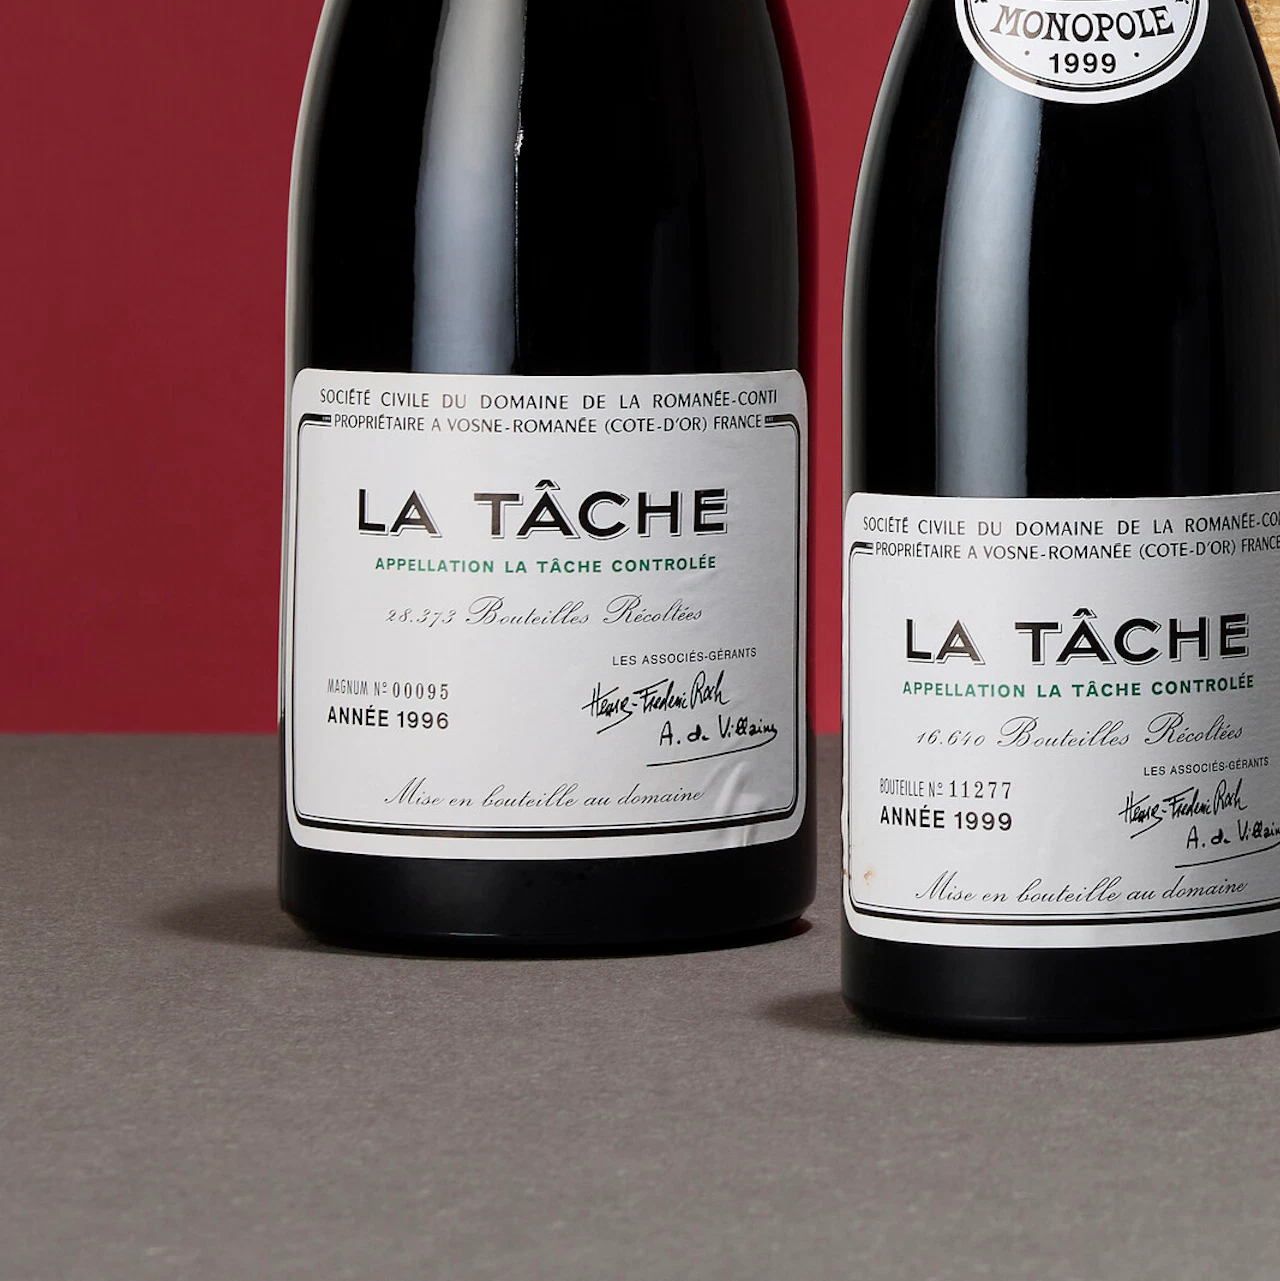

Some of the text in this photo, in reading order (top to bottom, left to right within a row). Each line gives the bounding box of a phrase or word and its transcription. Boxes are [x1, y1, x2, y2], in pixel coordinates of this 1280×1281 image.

[990, 5, 1175, 42] MONOPOLE
[1049, 53, 1116, 73] 1999
[320, 388, 777, 410] SOCIÉTÉ CIVILE DU DOMAINE DE LA ROMANÉE-CONTI
[334, 413, 763, 434] PROPRIÉTAIRE A VOSNE-ROMANÉE (COTE-D'OR) FRANCE
[358, 479, 728, 540] LA TÂCHE
[863, 516, 909, 534] SOCIÉTÉ
[918, 519, 966, 535] CIVILE
[978, 521, 1002, 536] DU
[1016, 521, 1103, 537] DOMAINE
[1118, 520, 1141, 535] DE
[1153, 519, 1174, 534] LA
[875, 541, 961, 559] PROPRIÉTAIRE
[968, 544, 978, 559] A
[984, 544, 1132, 560] VOSNE-ROMANÉE
[1139, 539, 1237, 560] (COTE-D'OR)
[375, 554, 716, 574] APPELLATION LA TÂCHE CONTROLÉE
[465, 595, 589, 626] Bouteilles
[603, 594, 703, 624] Récoltées
[905, 607, 1250, 666] LA TÂCHE
[612, 647, 757, 666] LES ASSOCIÉS-GÉRANTS
[328, 678, 368, 696] MAGNUM
[392, 682, 450, 700] 00095
[903, 674, 1254, 698] APPELLATION LA TÂCHE CONTROLÉE
[327, 705, 449, 729] ANNÉE 1996
[997, 716, 1130, 749] Bouteilles
[1145, 712, 1243, 746] Récoltées
[1144, 757, 1269, 776] LES ASSOCIÉS-GÉRANTS
[384, 776, 704, 808] Mise en bouteille au domaine
[880, 778, 925, 797] BOUTEILLE
[948, 782, 1012, 800] 11277
[880, 805, 1013, 831] ANNÉE 1999
[915, 870, 1248, 904] Mise en bouteille au domaine
